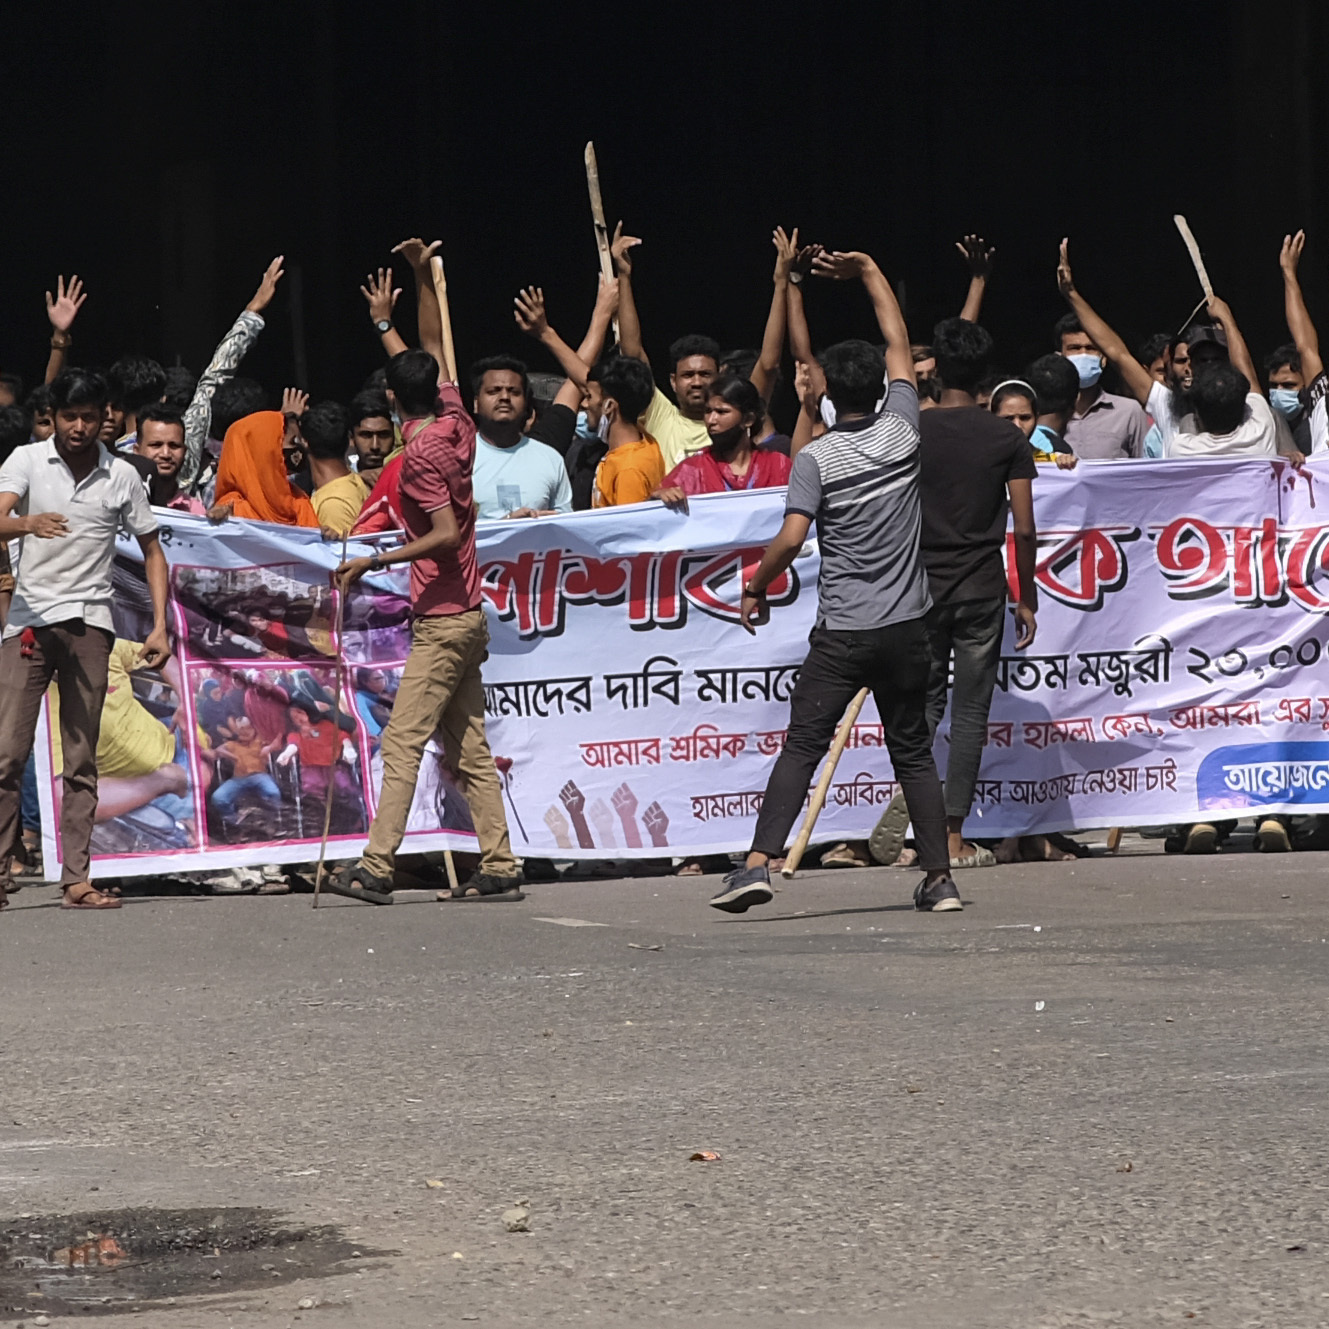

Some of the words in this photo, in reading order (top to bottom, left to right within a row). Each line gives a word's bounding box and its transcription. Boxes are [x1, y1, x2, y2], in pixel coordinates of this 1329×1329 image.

[604, 656, 683, 710] দাবি
[1077, 634, 1174, 699] মজুরী
[579, 737, 662, 769] আমার
[669, 723, 748, 762] শ্রমিক
[1023, 716, 1097, 750] হামলা
[1168, 700, 1261, 730] আমরা
[1272, 697, 1312, 724] এর
[1009, 772, 1078, 806] আওতায়
[1082, 766, 1139, 796] নেওয়া
[1145, 758, 1178, 793] চাই
